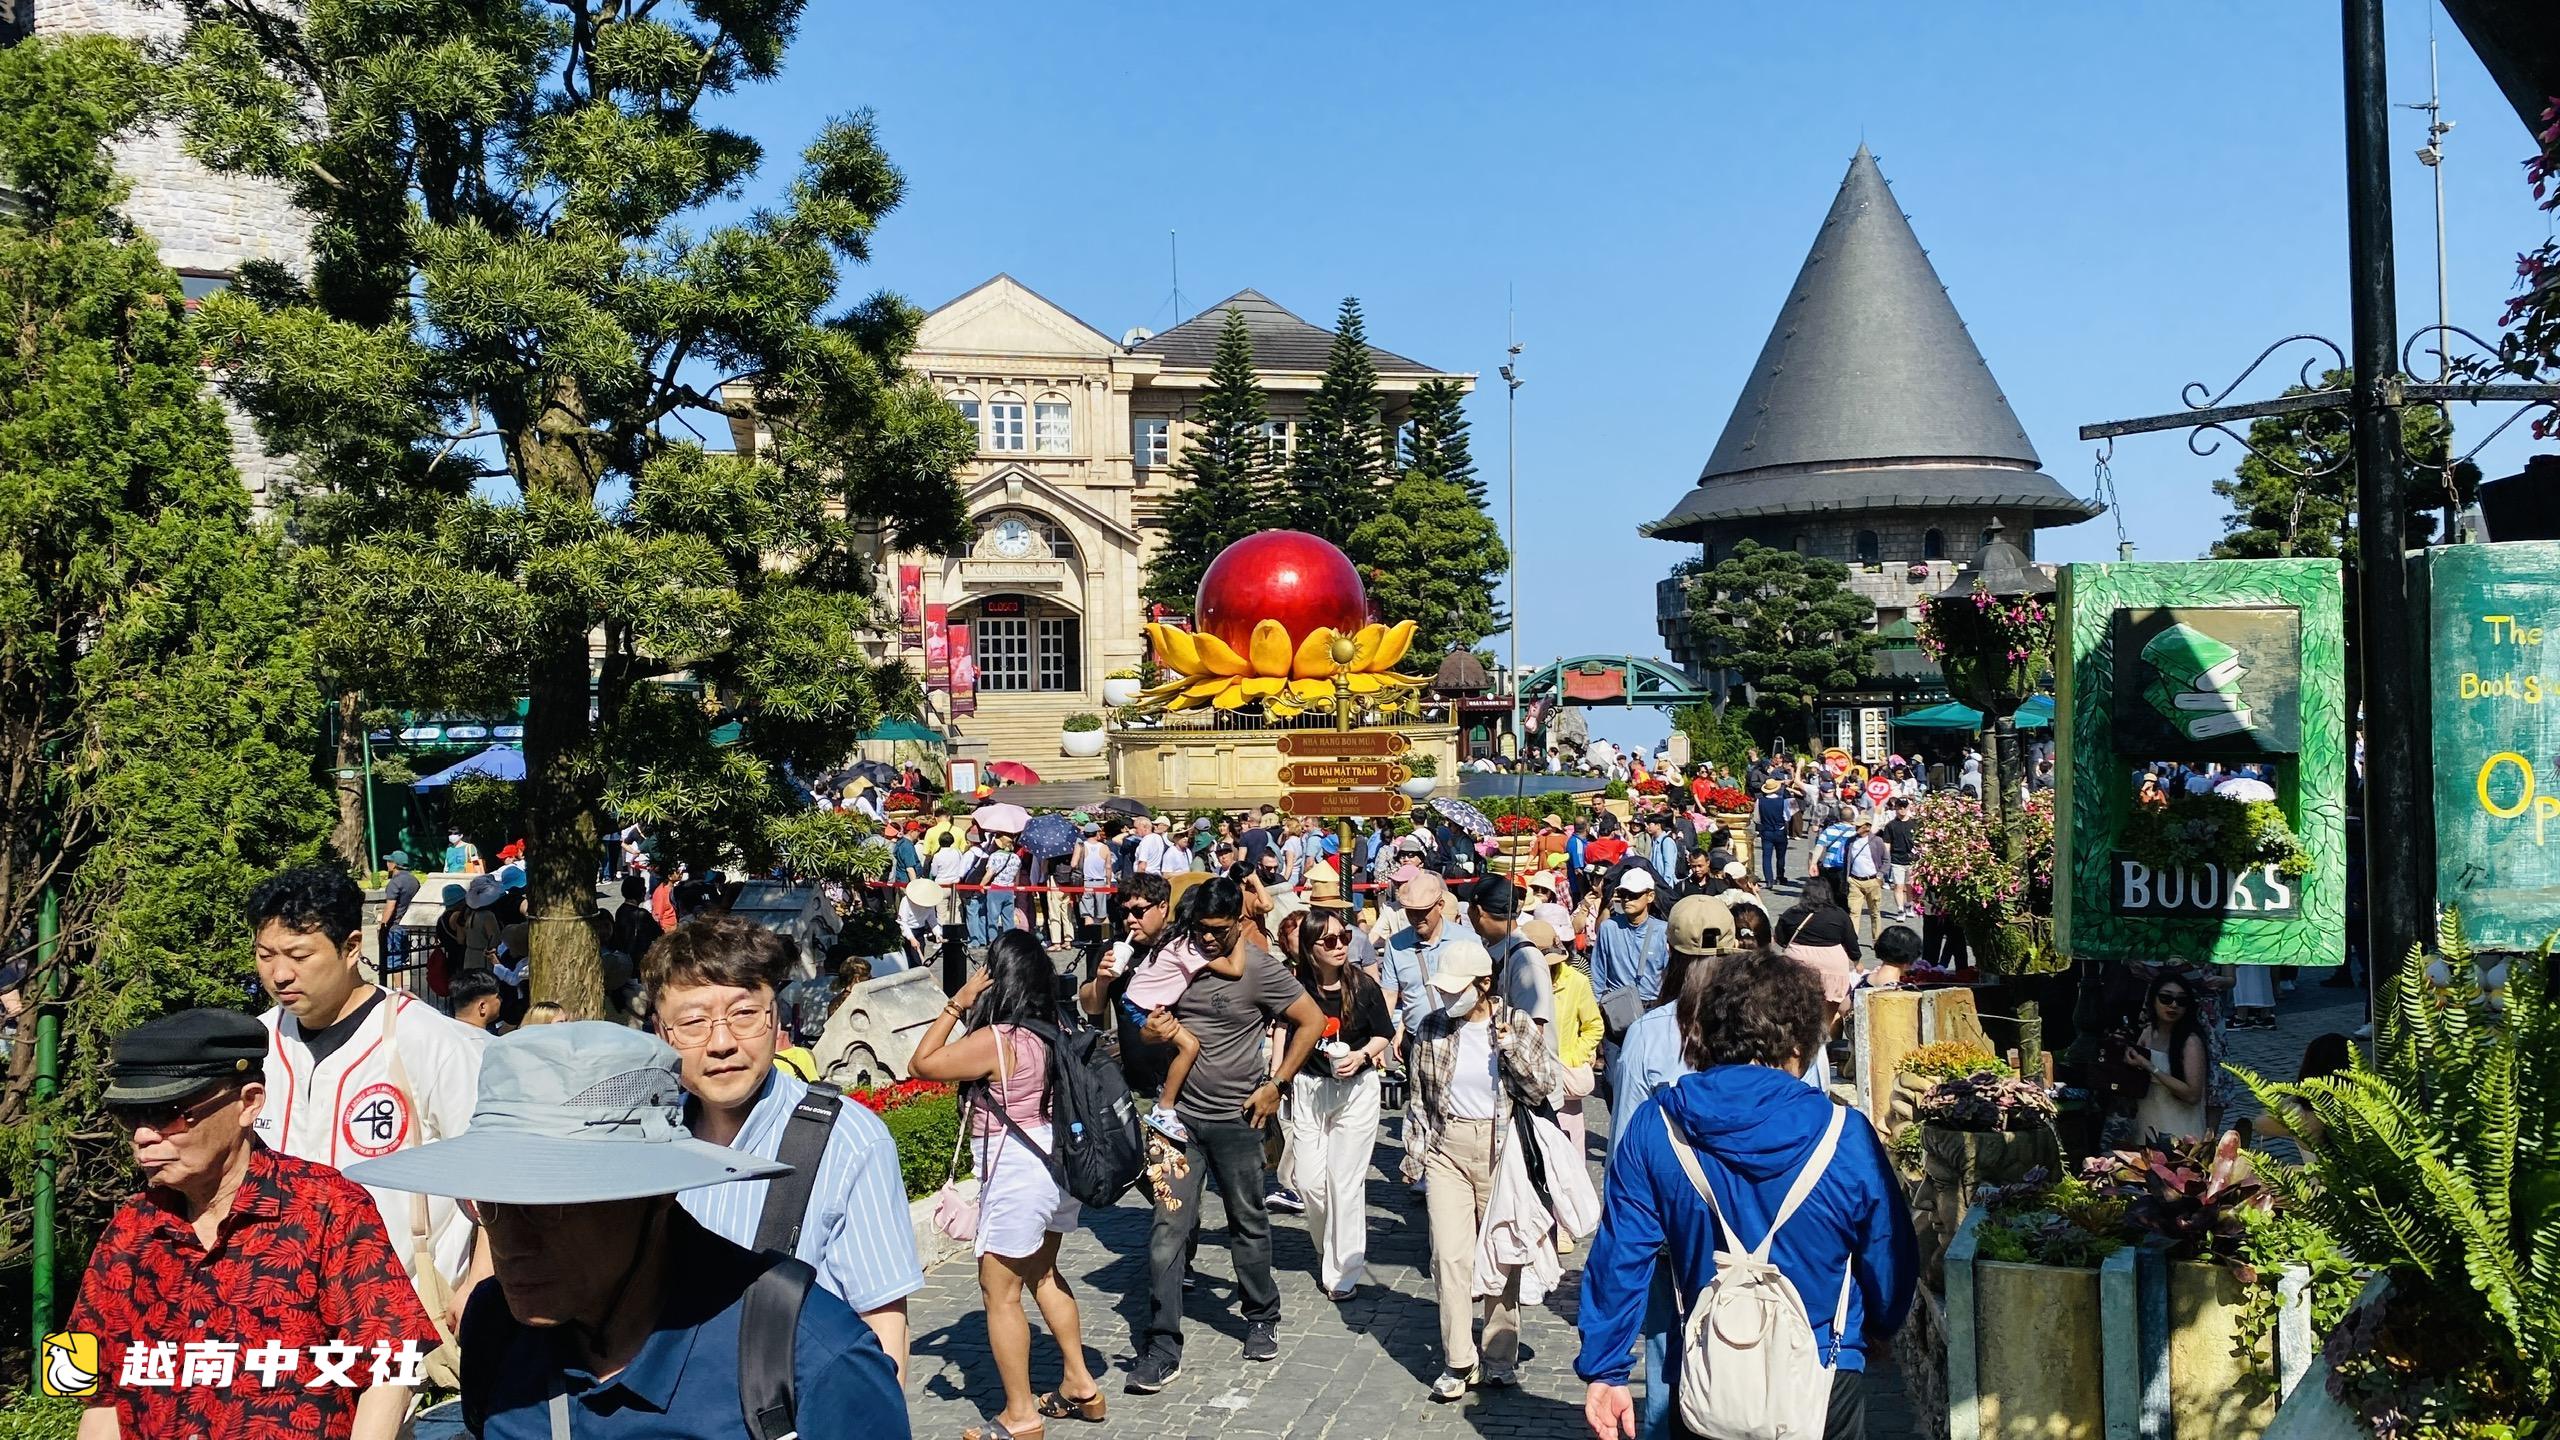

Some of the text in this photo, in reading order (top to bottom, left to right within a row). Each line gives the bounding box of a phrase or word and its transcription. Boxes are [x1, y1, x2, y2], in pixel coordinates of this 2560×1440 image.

[2482, 615, 2543, 645] The
[2460, 672, 2522, 700] Book
[2121, 861, 2291, 911] BOOKS
